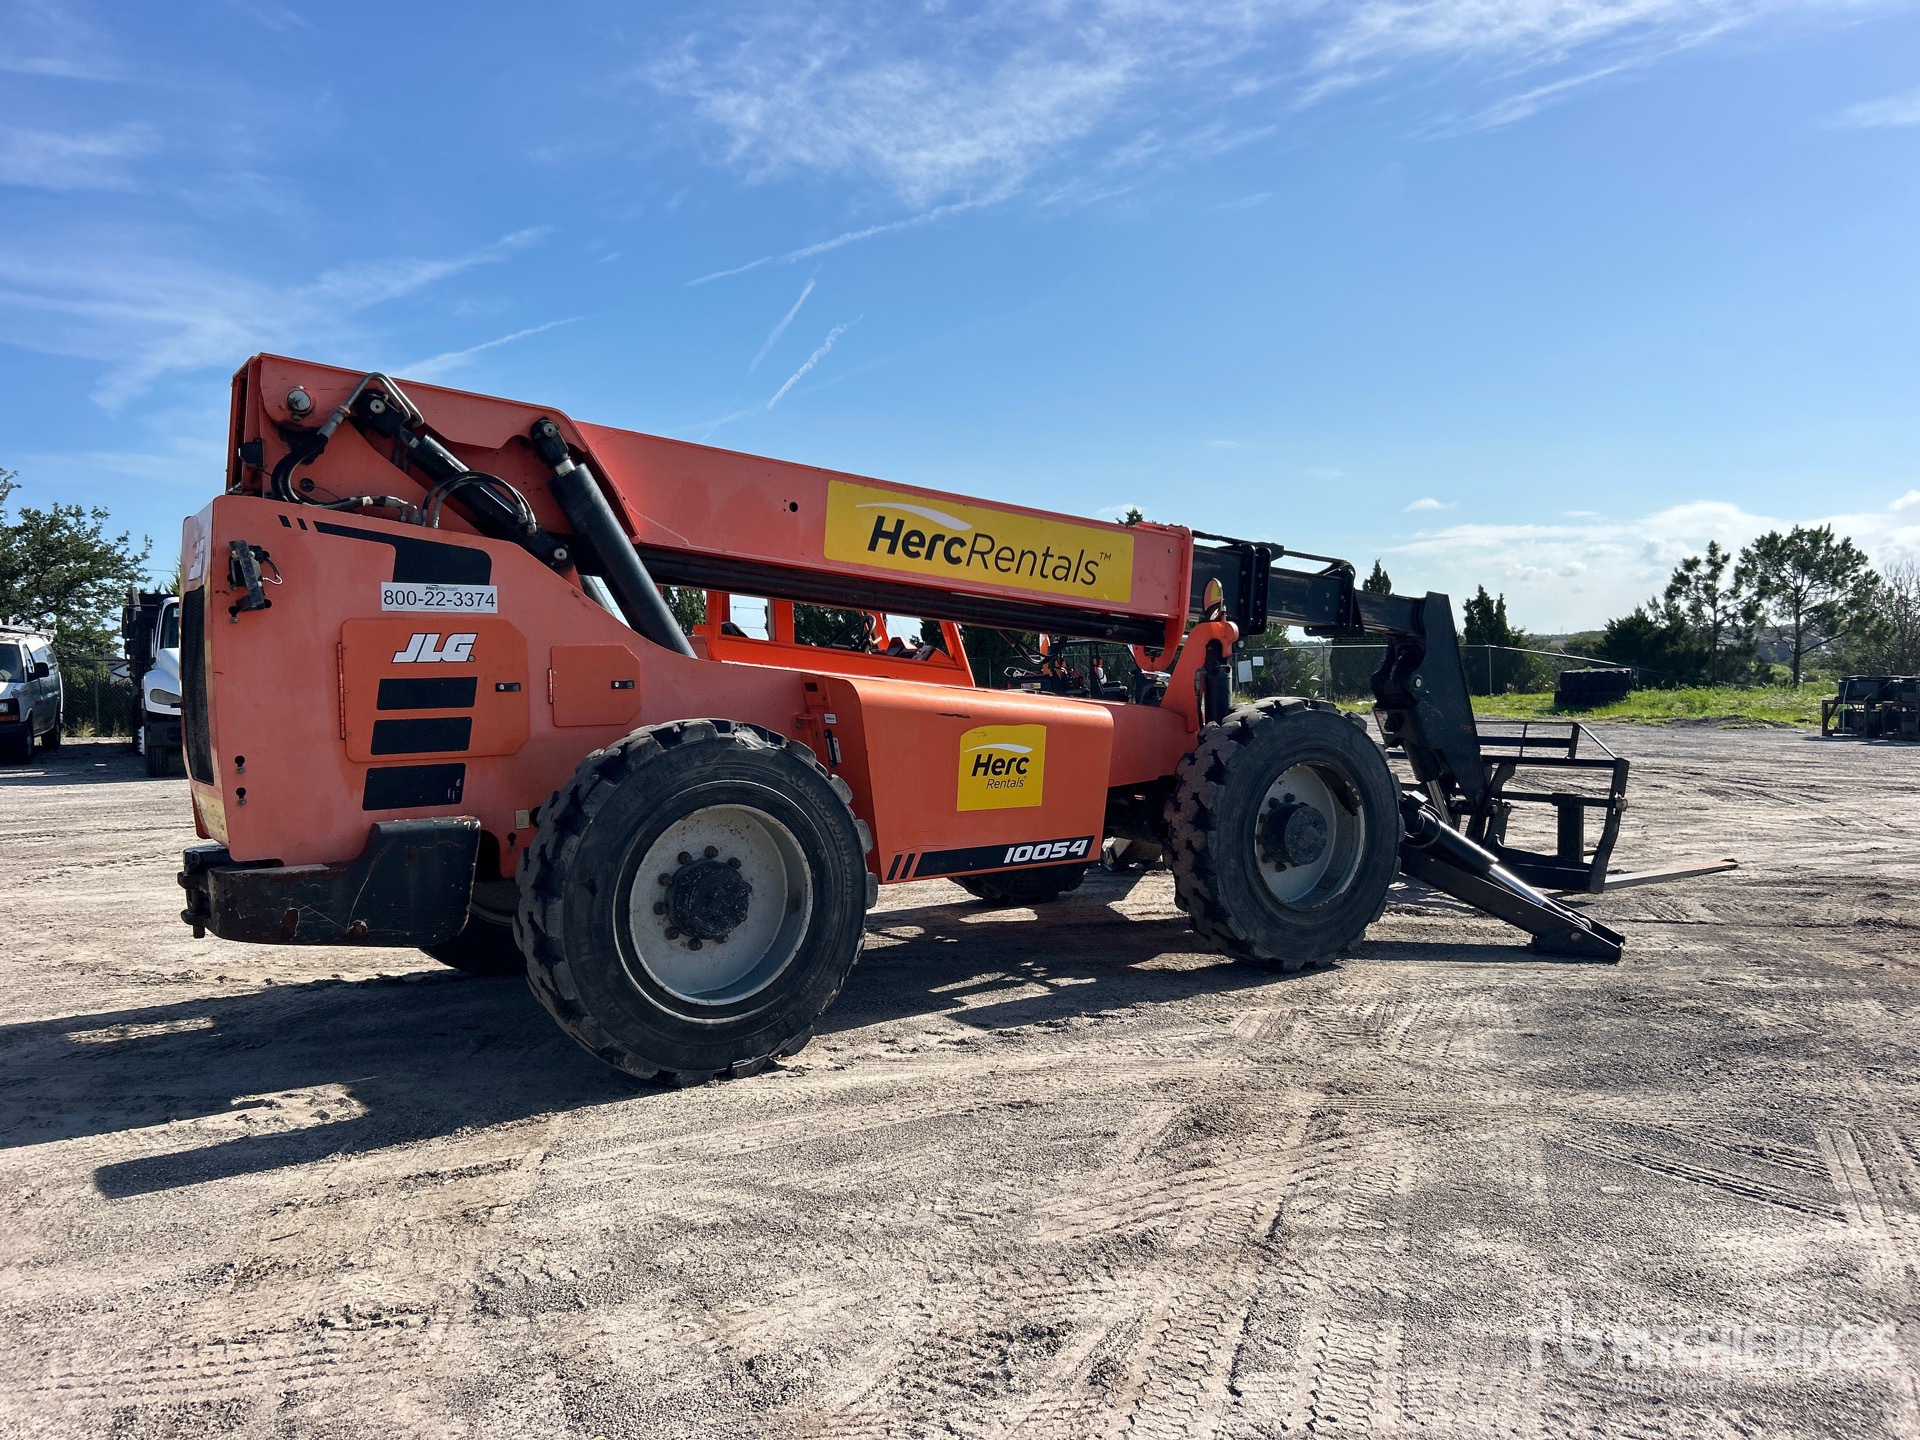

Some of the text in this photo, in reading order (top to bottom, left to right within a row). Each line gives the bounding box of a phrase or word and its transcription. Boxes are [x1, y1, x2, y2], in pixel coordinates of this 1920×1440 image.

[384, 590, 495, 607] 800-22-3374
[971, 753, 1031, 777] Herc
[1003, 839, 1088, 864] 10054
